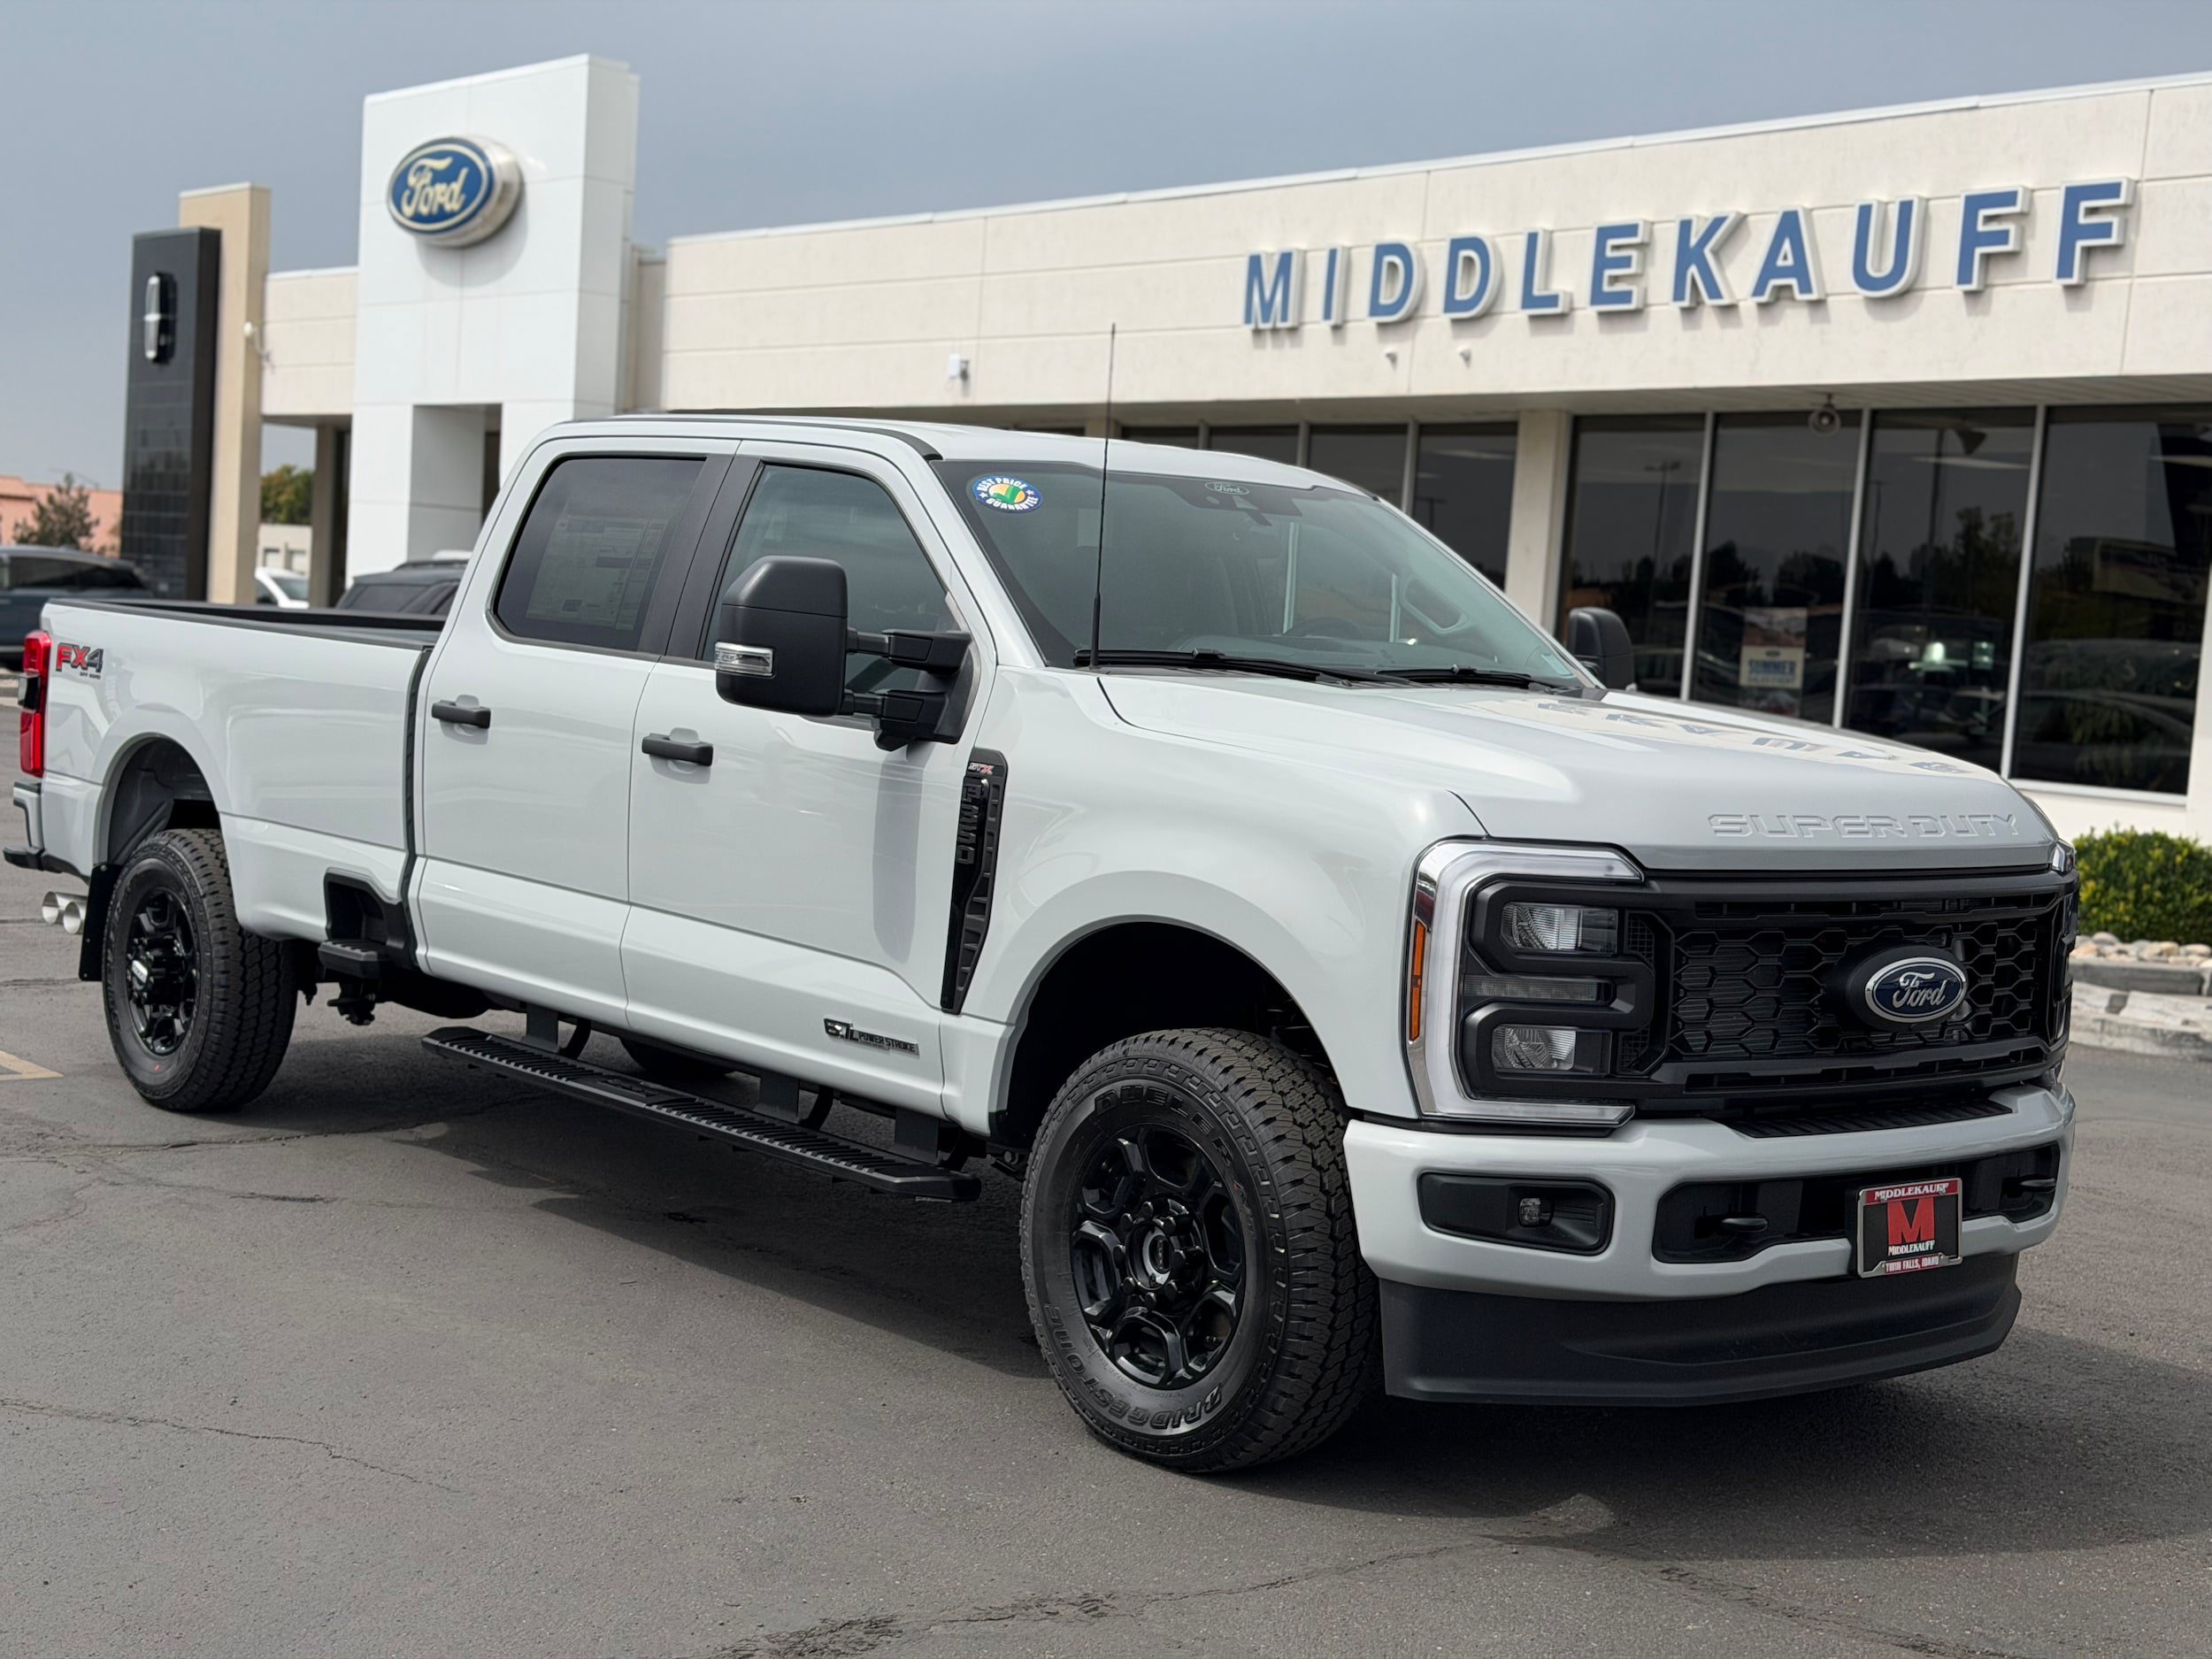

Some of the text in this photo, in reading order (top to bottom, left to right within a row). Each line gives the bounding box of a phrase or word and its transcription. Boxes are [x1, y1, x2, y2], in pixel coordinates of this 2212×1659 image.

[401, 156, 469, 219] Ford
[1242, 177, 2136, 333] MIDDLEKAUFF
[976, 477, 1028, 492] BEST PRICE
[55, 642, 104, 673] FX4
[968, 762, 995, 775] STX
[1708, 814, 2019, 838] SUPER DUTY
[1892, 971, 1948, 1009] Ford
[858, 1032, 885, 1045] POWER
[885, 1036, 916, 1053] STROKE
[1887, 1196, 1935, 1246] M
[1887, 1240, 1936, 1256] MIDDLEKAUFF
[1886, 1261, 1901, 1272] TWIN
[1043, 1302, 1224, 1431] BRIDGESTONE
